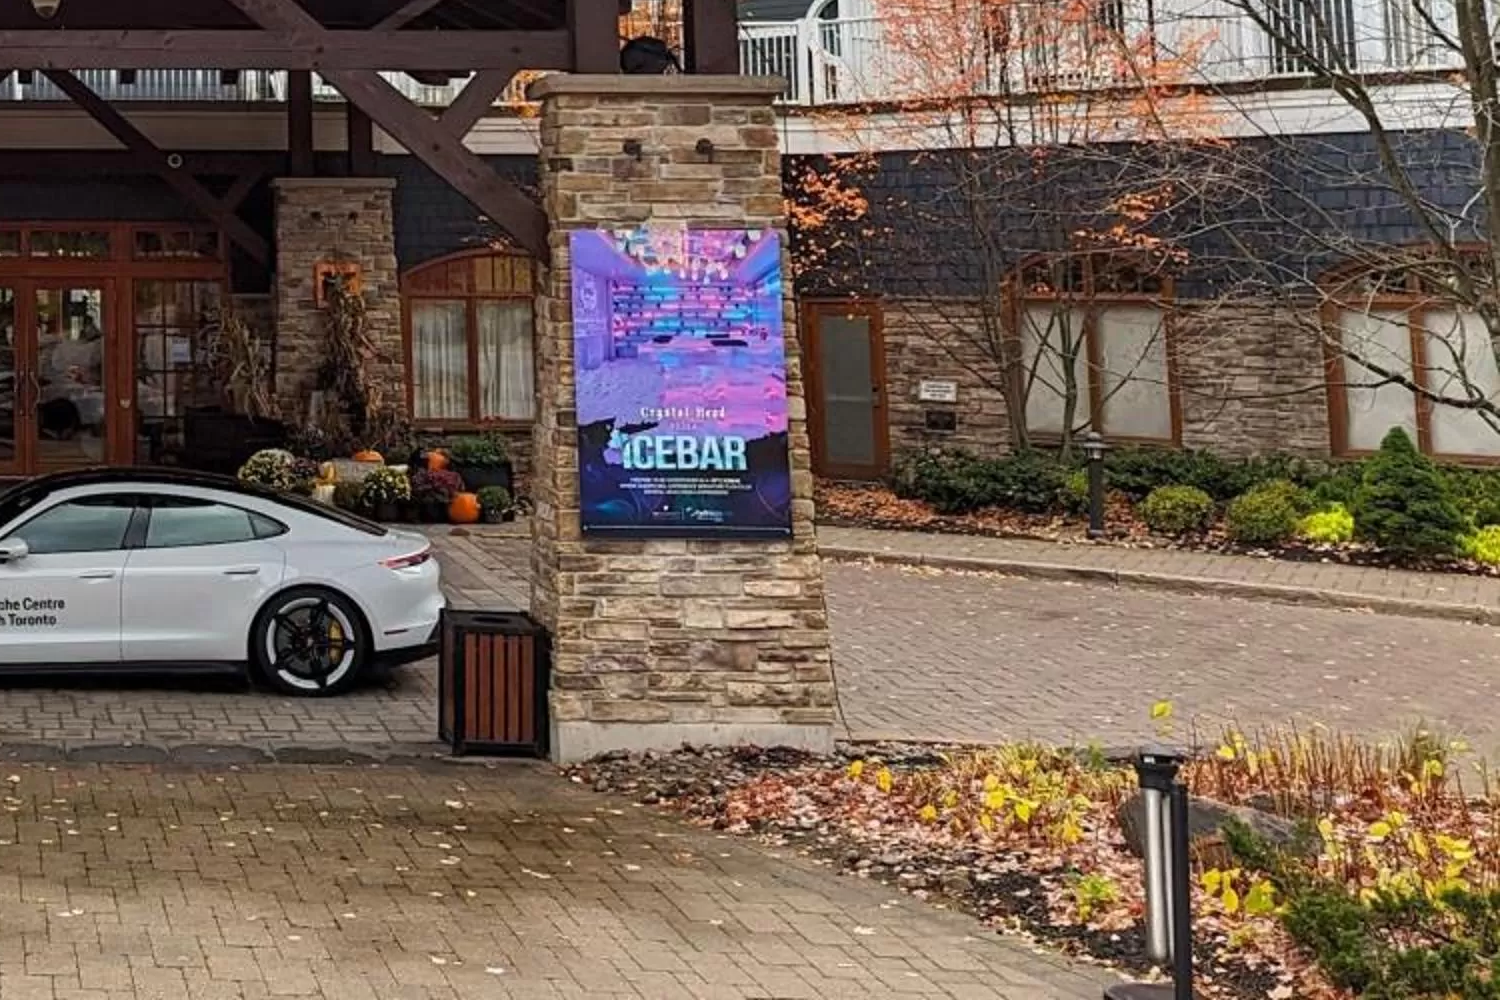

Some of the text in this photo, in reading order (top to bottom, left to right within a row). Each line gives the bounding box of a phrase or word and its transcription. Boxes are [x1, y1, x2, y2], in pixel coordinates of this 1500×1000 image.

[640, 406, 725, 420] Crystal Head
[623, 435, 747, 470] ICEBAR
[22, 597, 65, 611] Centre
[8, 613, 57, 626] Toronto
